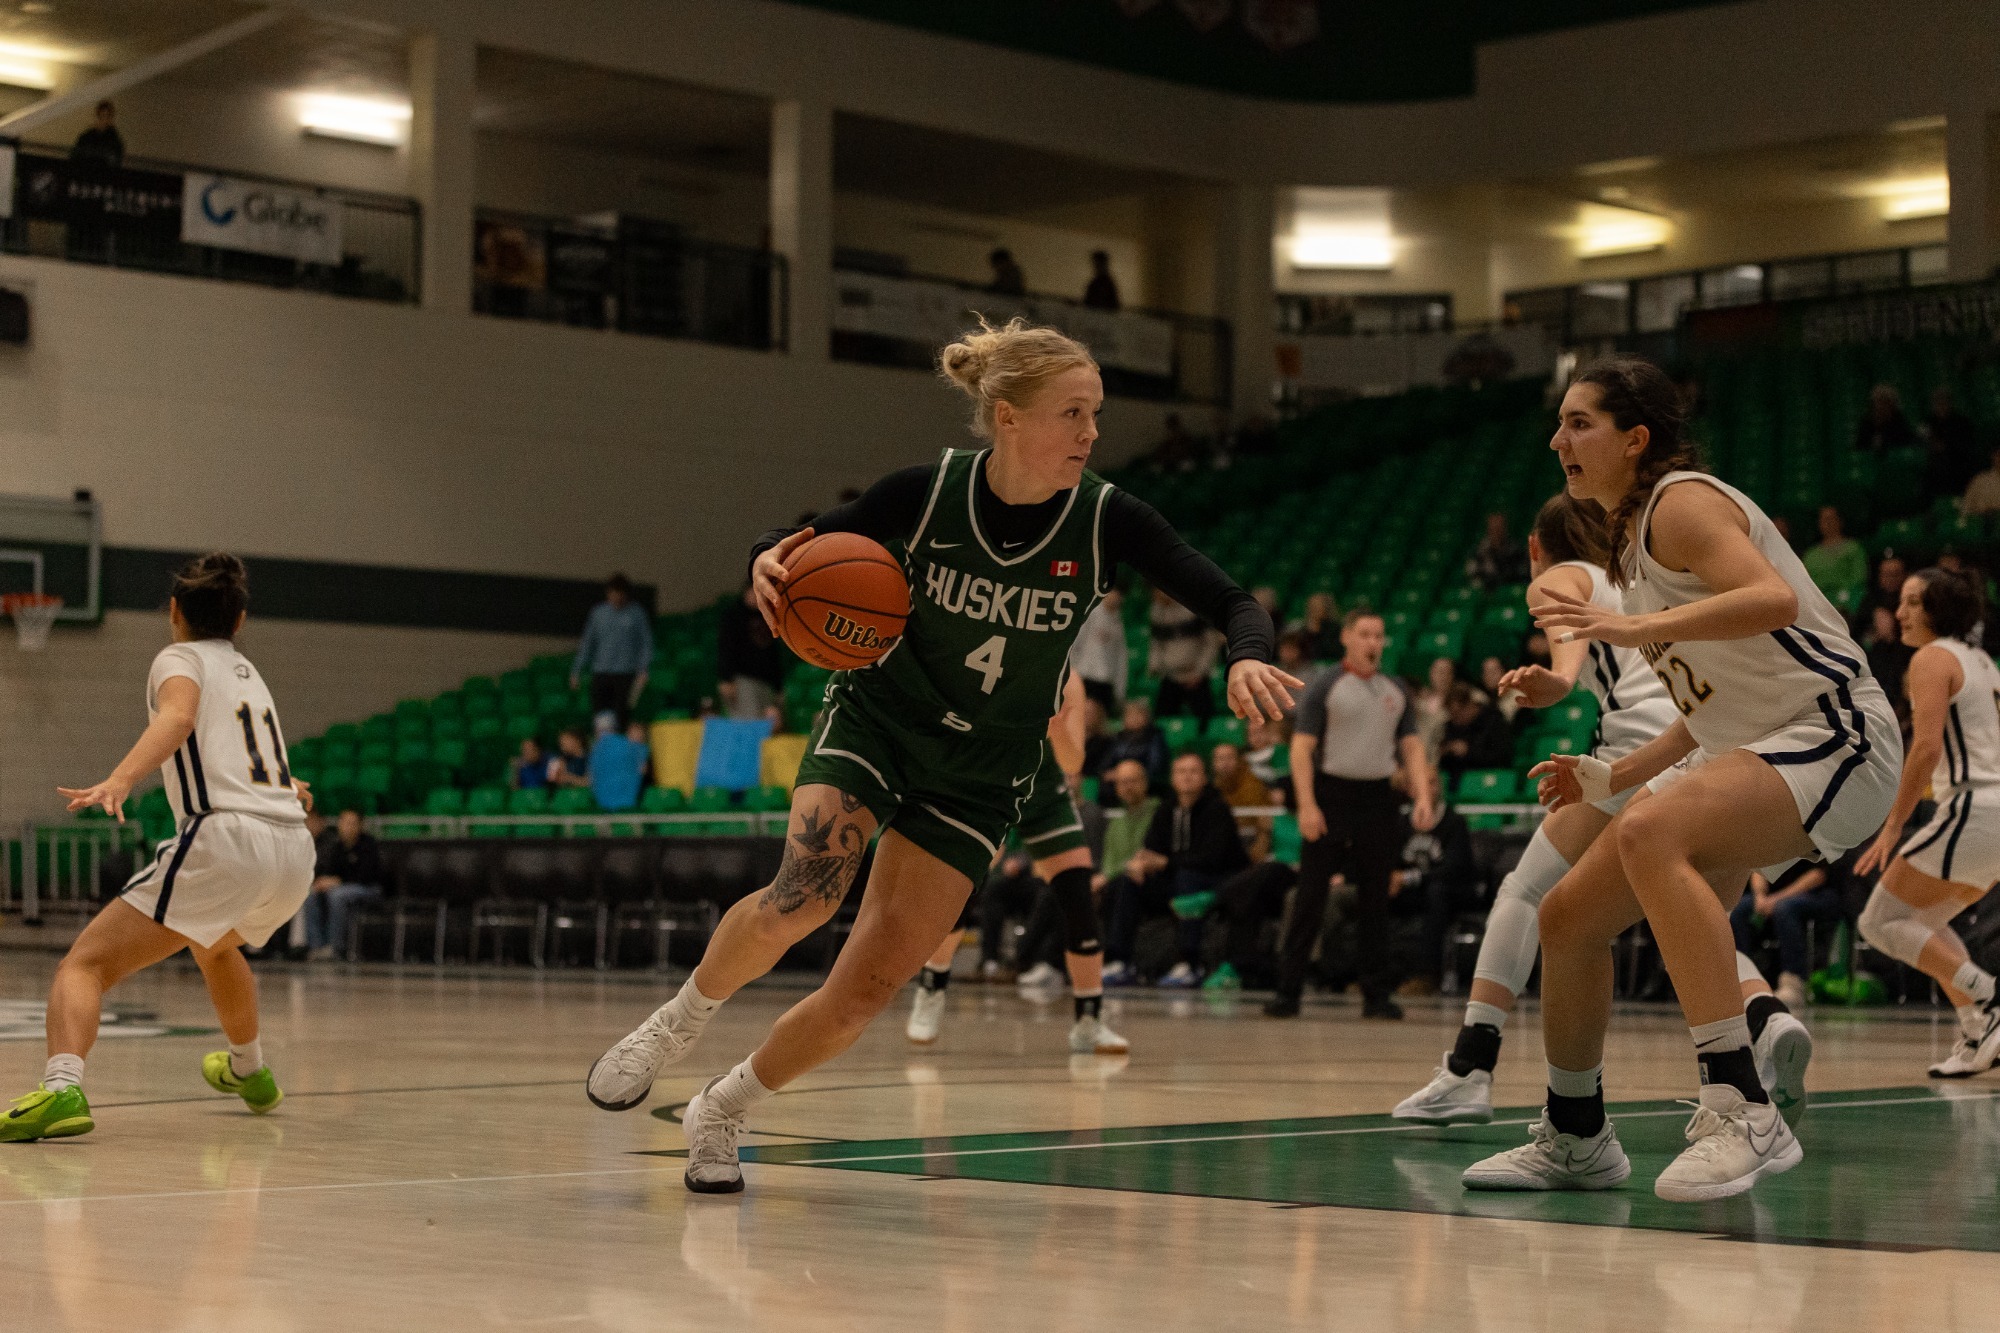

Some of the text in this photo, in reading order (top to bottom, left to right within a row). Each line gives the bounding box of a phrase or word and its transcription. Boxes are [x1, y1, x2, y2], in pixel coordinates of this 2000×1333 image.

[925, 563, 1077, 631] HUSKIES
[965, 635, 1007, 695] 4
[1656, 654, 1714, 717] 22
[236, 701, 293, 789] 11
